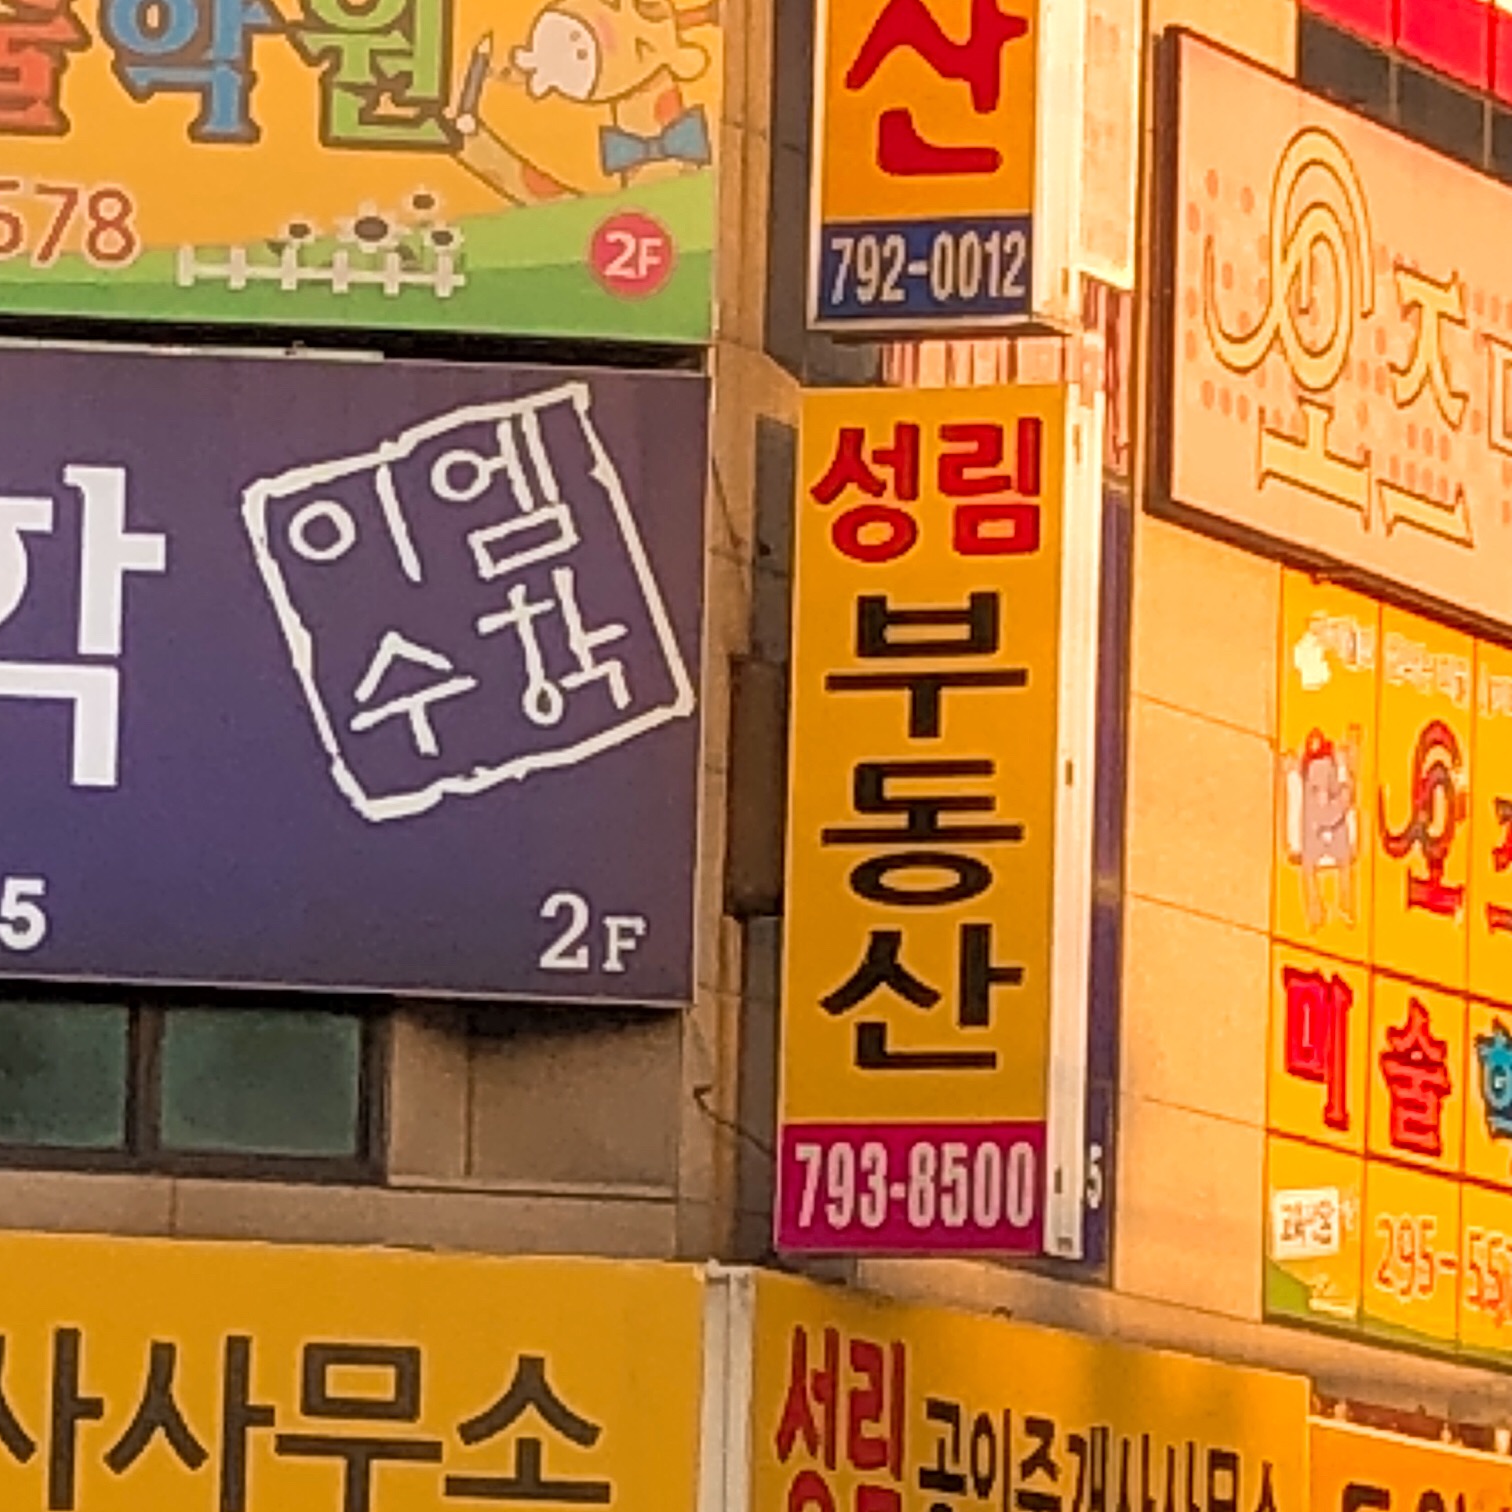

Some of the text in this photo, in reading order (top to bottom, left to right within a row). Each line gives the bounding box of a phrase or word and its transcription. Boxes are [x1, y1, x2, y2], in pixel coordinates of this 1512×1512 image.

[846, 0, 1029, 177] 산
[605, 232, 666, 280] 2F
[830, 231, 1029, 308] 792-0012
[810, 416, 1041, 563] 성림
[350, 566, 630, 760] 수학
[819, 590, 1030, 1072] 부동산
[538, 892, 647, 974] 2F
[794, 1140, 1036, 1232] 793-8500
[1375, 1214, 1512, 1315] 295-55
